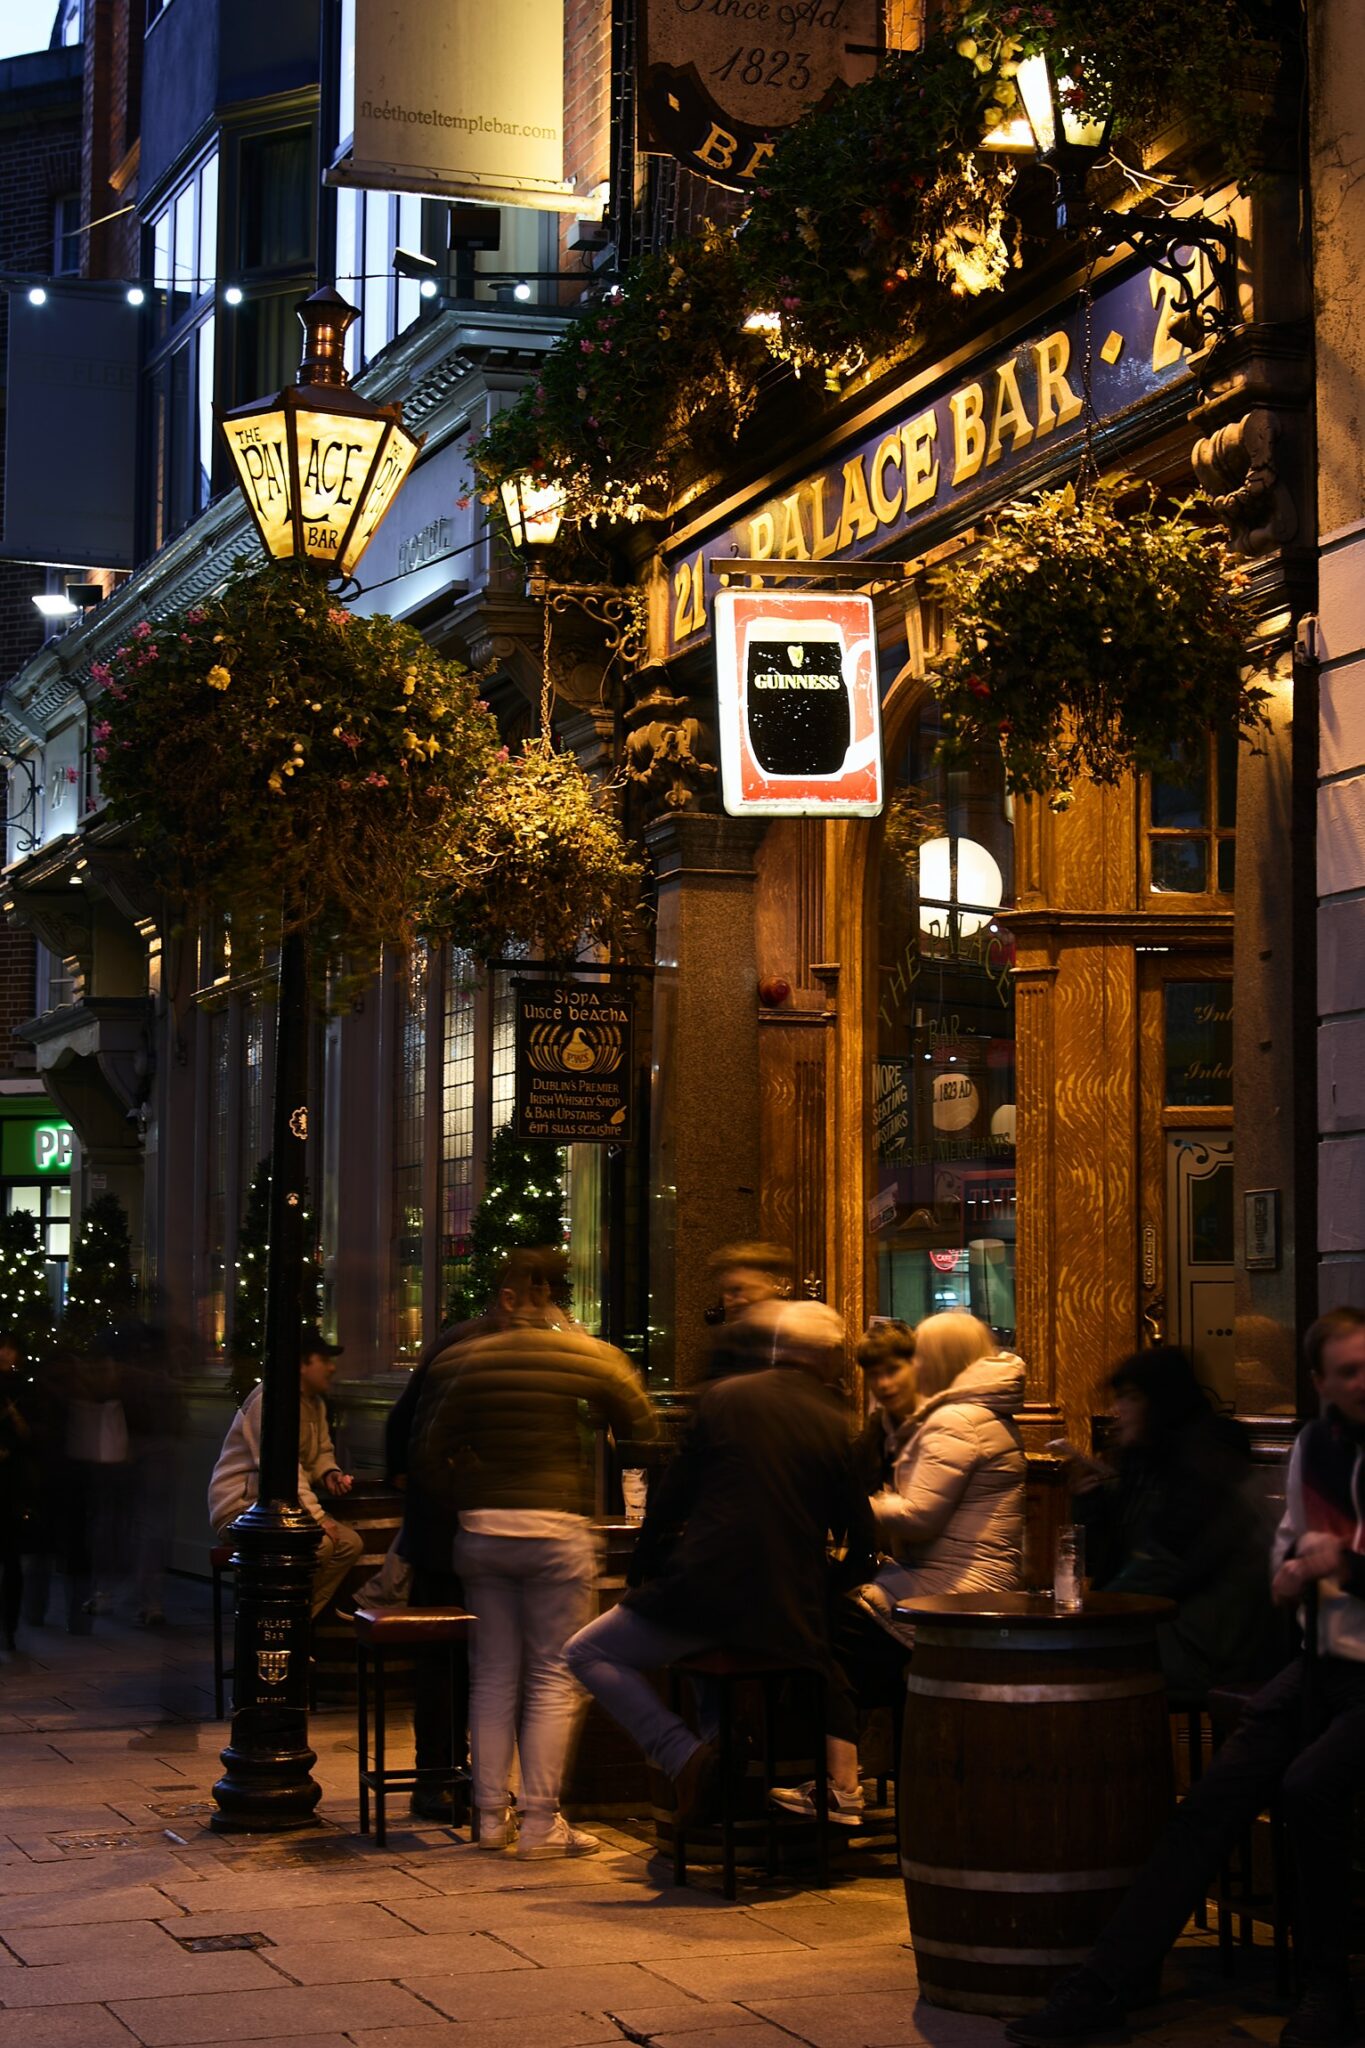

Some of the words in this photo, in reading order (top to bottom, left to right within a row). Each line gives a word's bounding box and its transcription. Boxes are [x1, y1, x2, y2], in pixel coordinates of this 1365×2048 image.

[709, 46, 811, 90] 1823
[359, 101, 558, 140] fleethoteltemplebar.com
[235, 426, 262, 444] THE
[240, 438, 363, 526] PALACE
[674, 551, 707, 643] 21
[748, 409, 939, 590] PALACE
[950, 330, 1084, 487] BAR
[307, 526, 339, 549] BAR
[754, 673, 841, 691] GUINNESS
[928, 1014, 961, 1050] BAR
[578, 1080, 620, 1093] PREMIER
[871, 1064, 903, 1104] MORE
[958, 1079, 973, 1100] AD
[524, 1106, 533, 1119] &
[529, 1092, 554, 1105] IRISH
[554, 1093, 595, 1107] WHISKEY
[596, 1095, 621, 1108] SHOP
[872, 1084, 908, 1126] SEATING
[871, 1109, 909, 1150] UPSTAIRS
[264, 1630, 286, 1641] BAR
